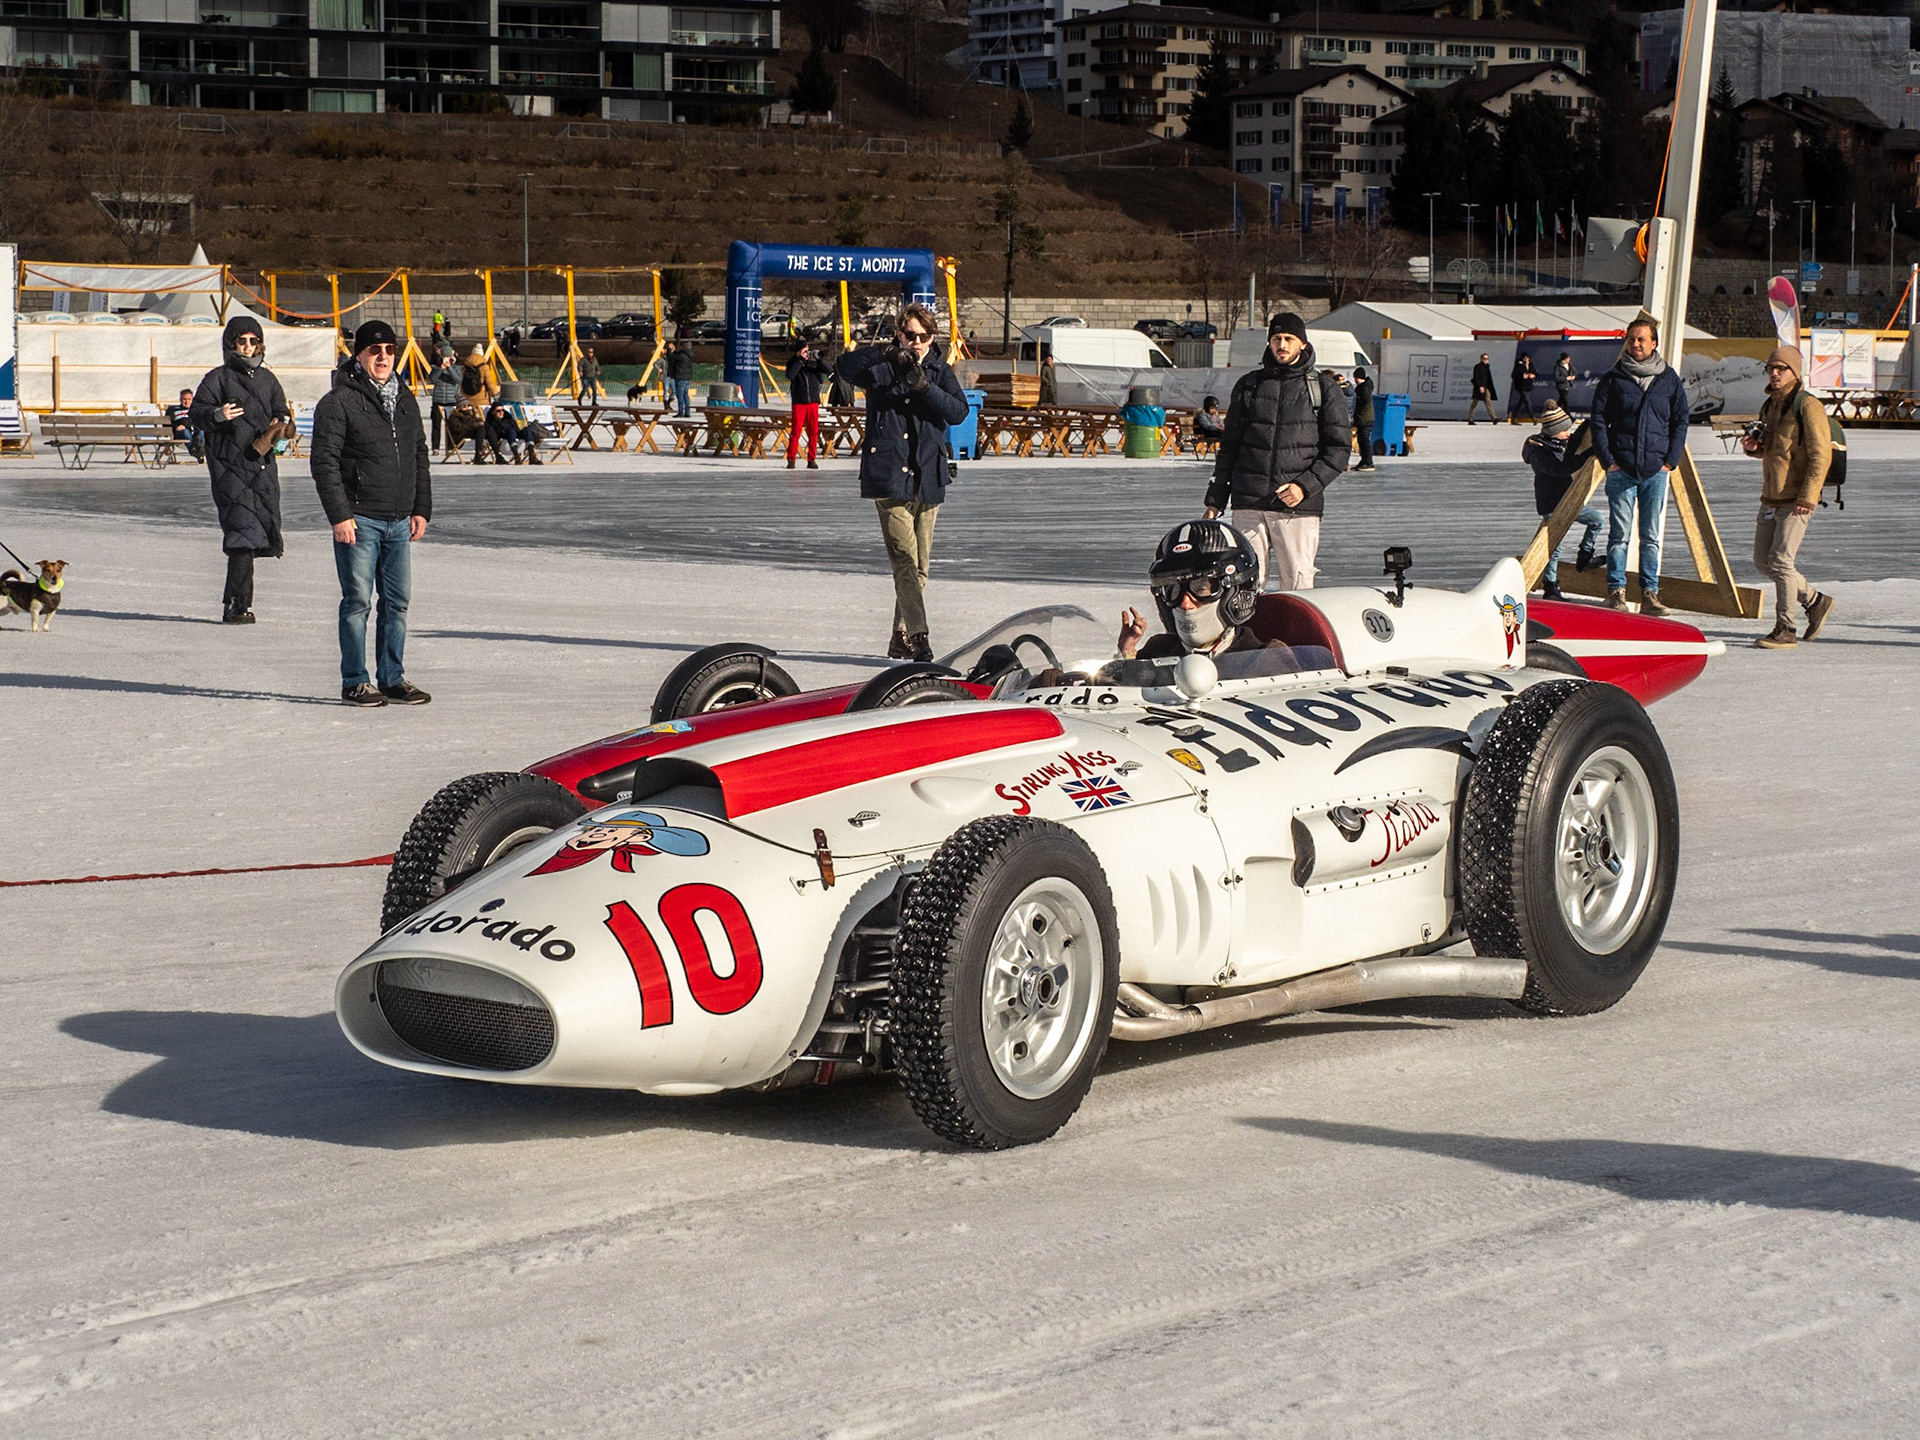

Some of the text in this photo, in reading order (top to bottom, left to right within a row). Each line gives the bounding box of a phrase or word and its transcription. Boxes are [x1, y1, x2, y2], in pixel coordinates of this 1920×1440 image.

[787, 255, 905, 273] THE ICE ST. MORITZ
[1416, 365, 1439, 378] THE
[1416, 381, 1438, 393] ICE
[1366, 616, 1391, 634] 312
[1136, 669, 1515, 773] Eldorado
[995, 750, 1117, 816] STIRLING MOSS
[603, 882, 764, 1030] 10
